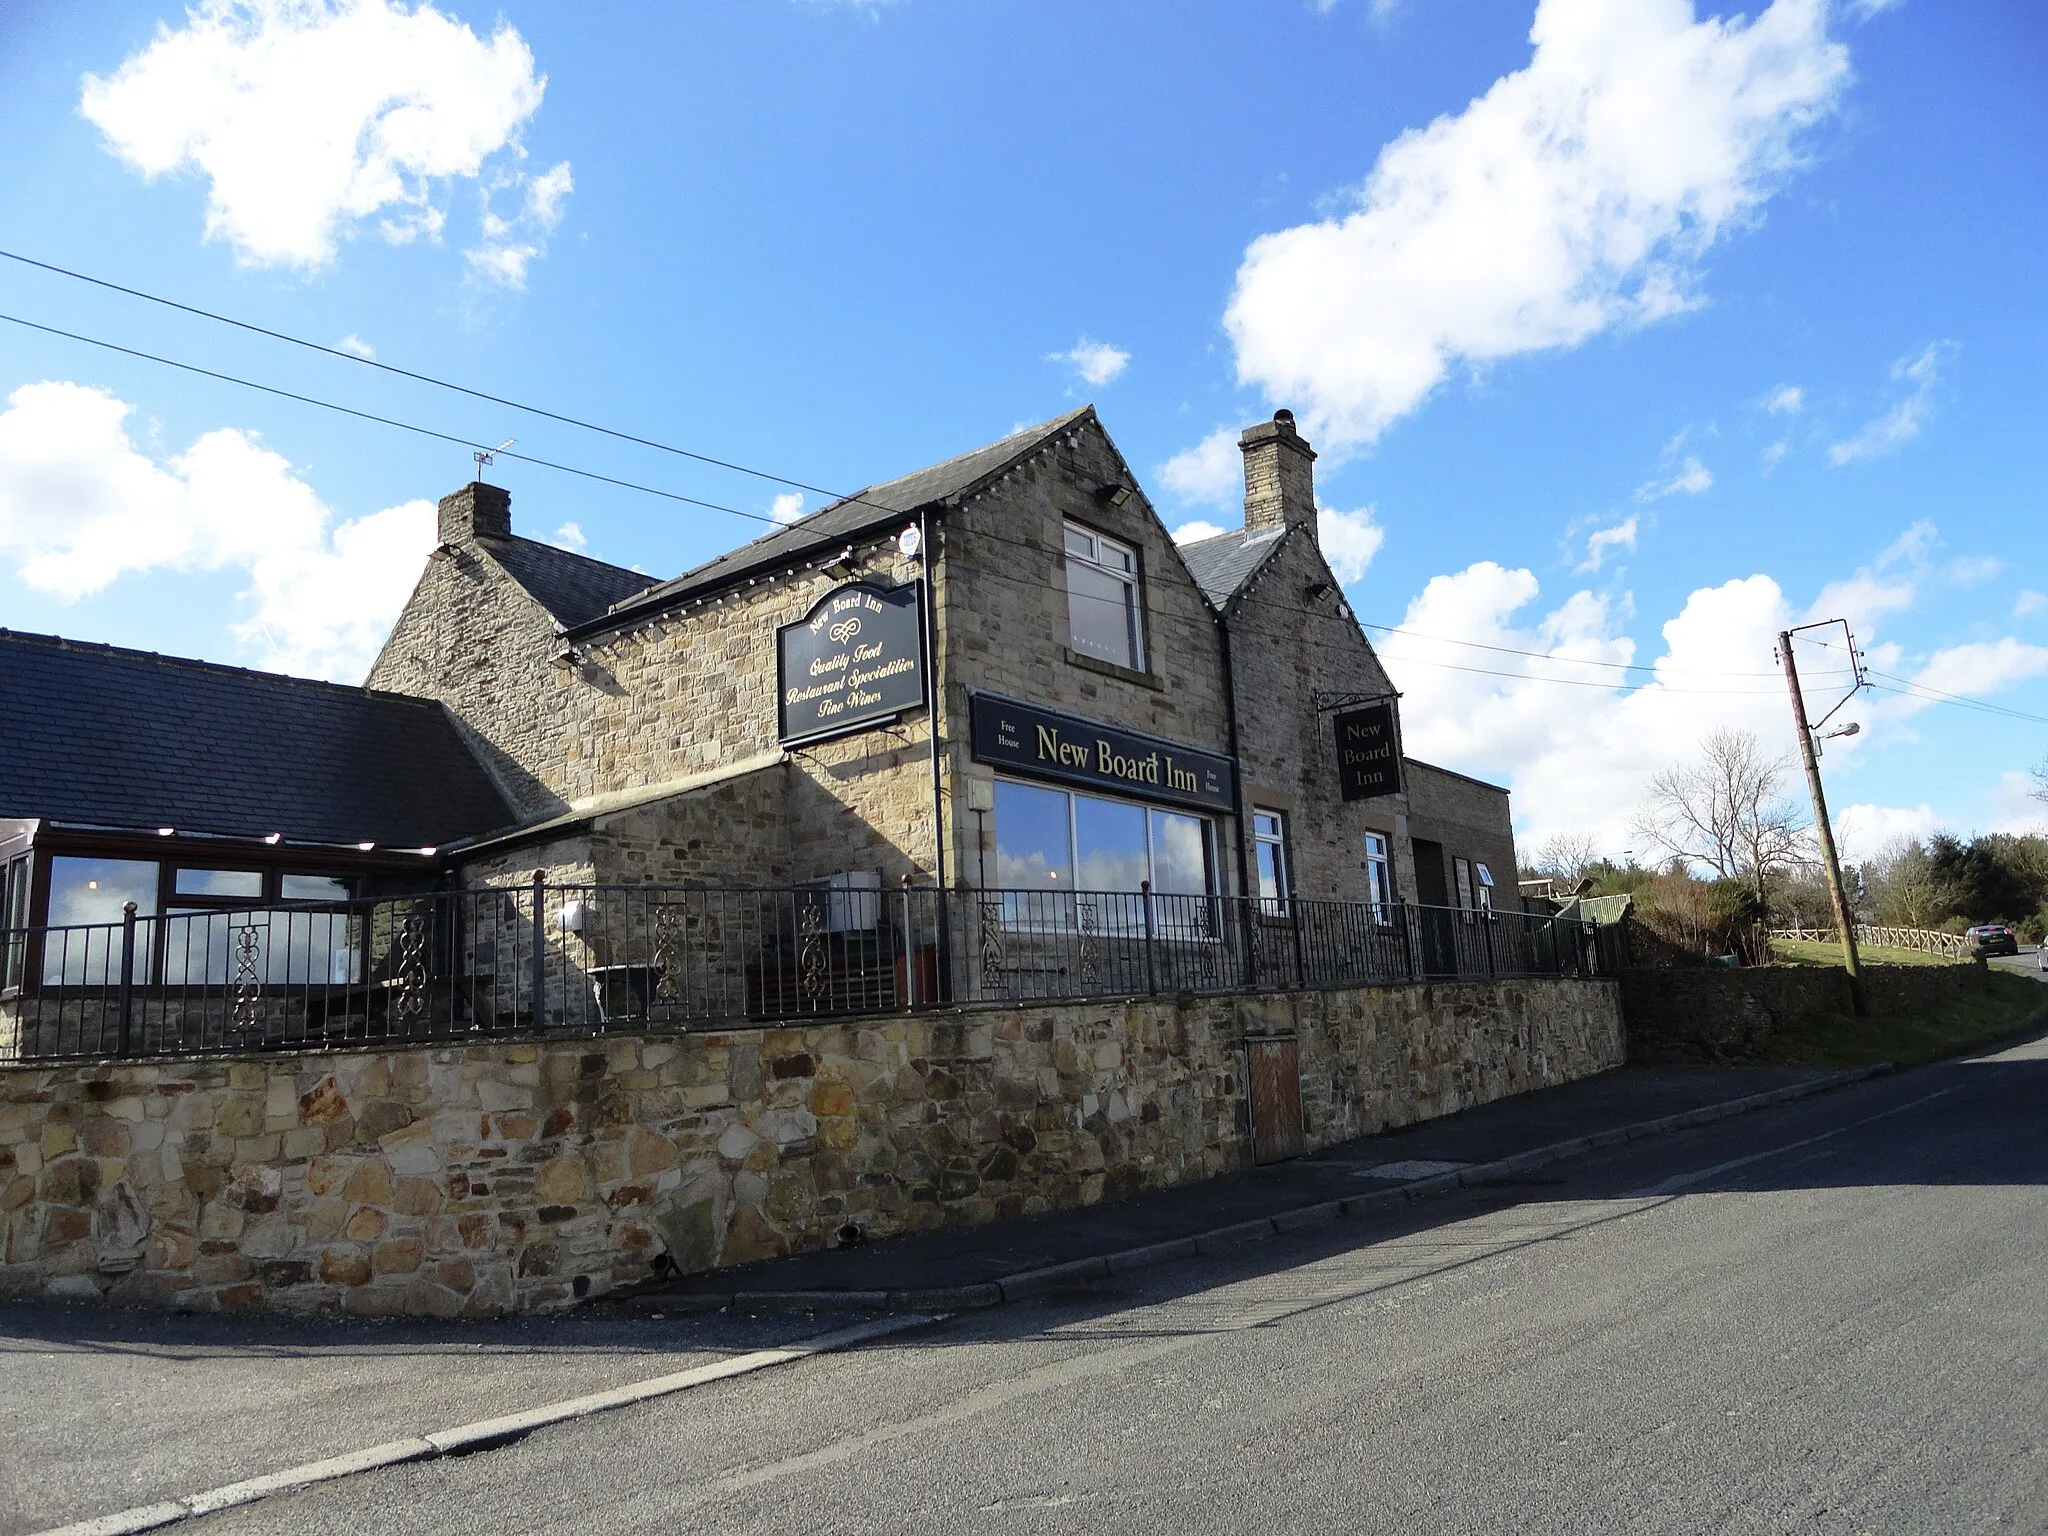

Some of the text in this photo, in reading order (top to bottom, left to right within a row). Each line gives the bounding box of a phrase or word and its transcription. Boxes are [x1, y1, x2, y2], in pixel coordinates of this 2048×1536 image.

[809, 592, 884, 636] New Board Inn
[809, 641, 884, 677] Quality Food
[785, 657, 915, 706] Restaurant Specialities
[817, 689, 882, 718] Fine Wines
[1001, 720, 1016, 733] Free
[1346, 723, 1381, 741] New
[998, 734, 1020, 749] House
[1343, 741, 1391, 765] Board
[1036, 724, 1198, 793] New Board Inn
[1356, 770, 1384, 787] Inn
